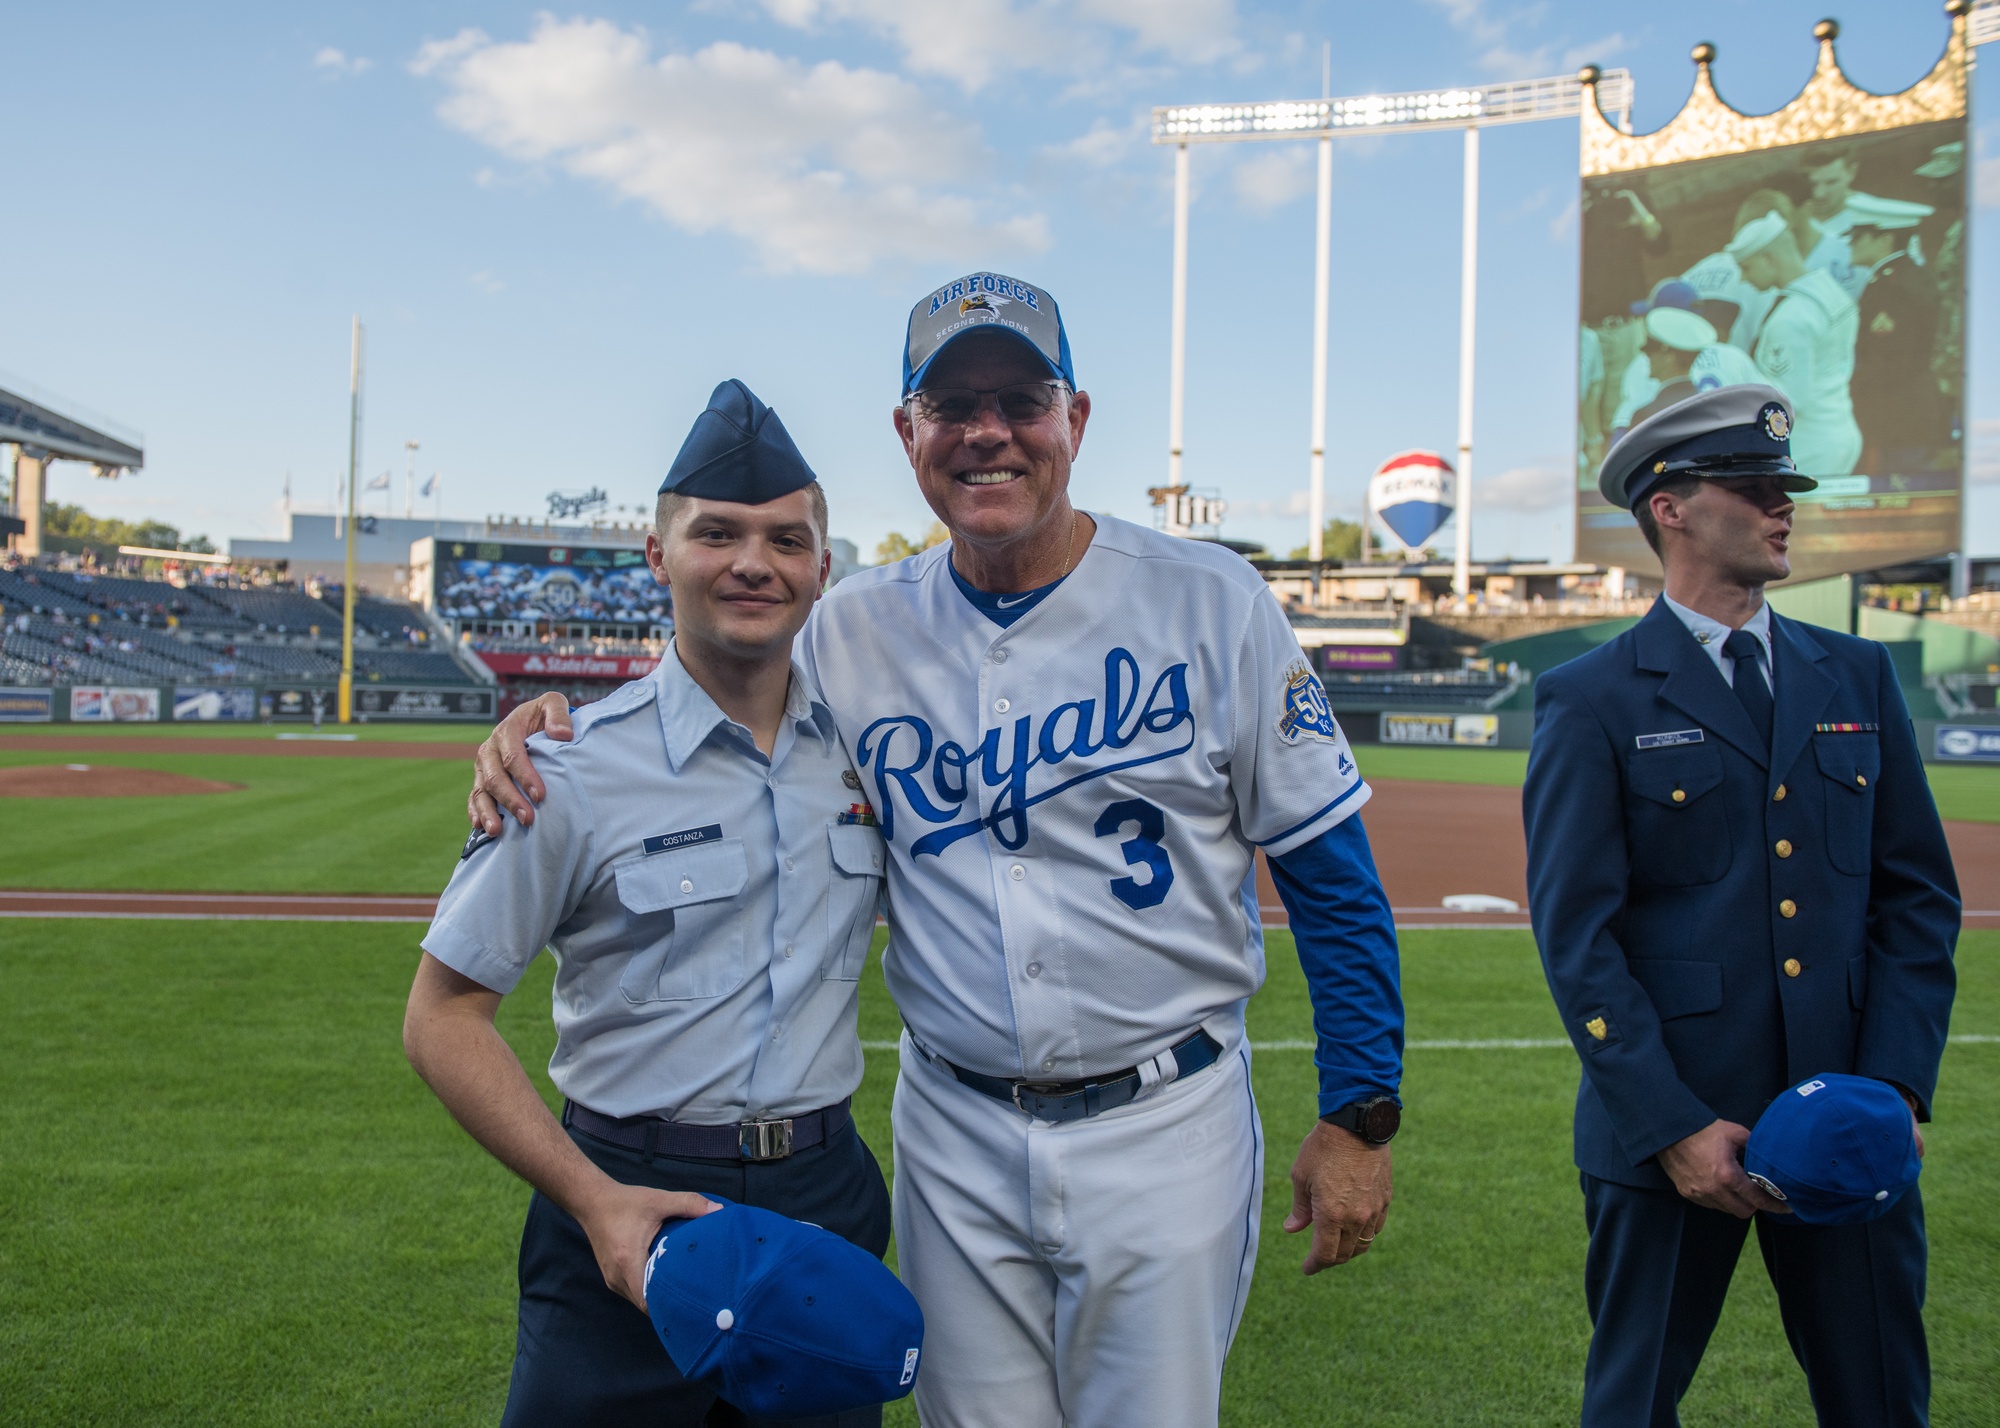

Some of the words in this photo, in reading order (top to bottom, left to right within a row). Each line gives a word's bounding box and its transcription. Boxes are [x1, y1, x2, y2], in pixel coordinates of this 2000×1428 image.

[928, 281, 963, 318] AIR
[968, 275, 1039, 312] FORCE
[936, 317, 975, 340] SECOND
[980, 315, 996, 324] TO
[1000, 317, 1030, 335] NONE
[546, 485, 609, 518] Royals
[486, 514, 560, 541] HALL
[592, 519, 650, 544] FAM
[545, 583, 576, 607] 50
[545, 656, 582, 672] State
[580, 659, 618, 675] Farm
[1291, 682, 1328, 725] 50
[1319, 718, 1333, 734] KC
[857, 647, 1195, 863] Royals
[662, 831, 705, 847] COSTANZA
[1094, 798, 1175, 911] 3
